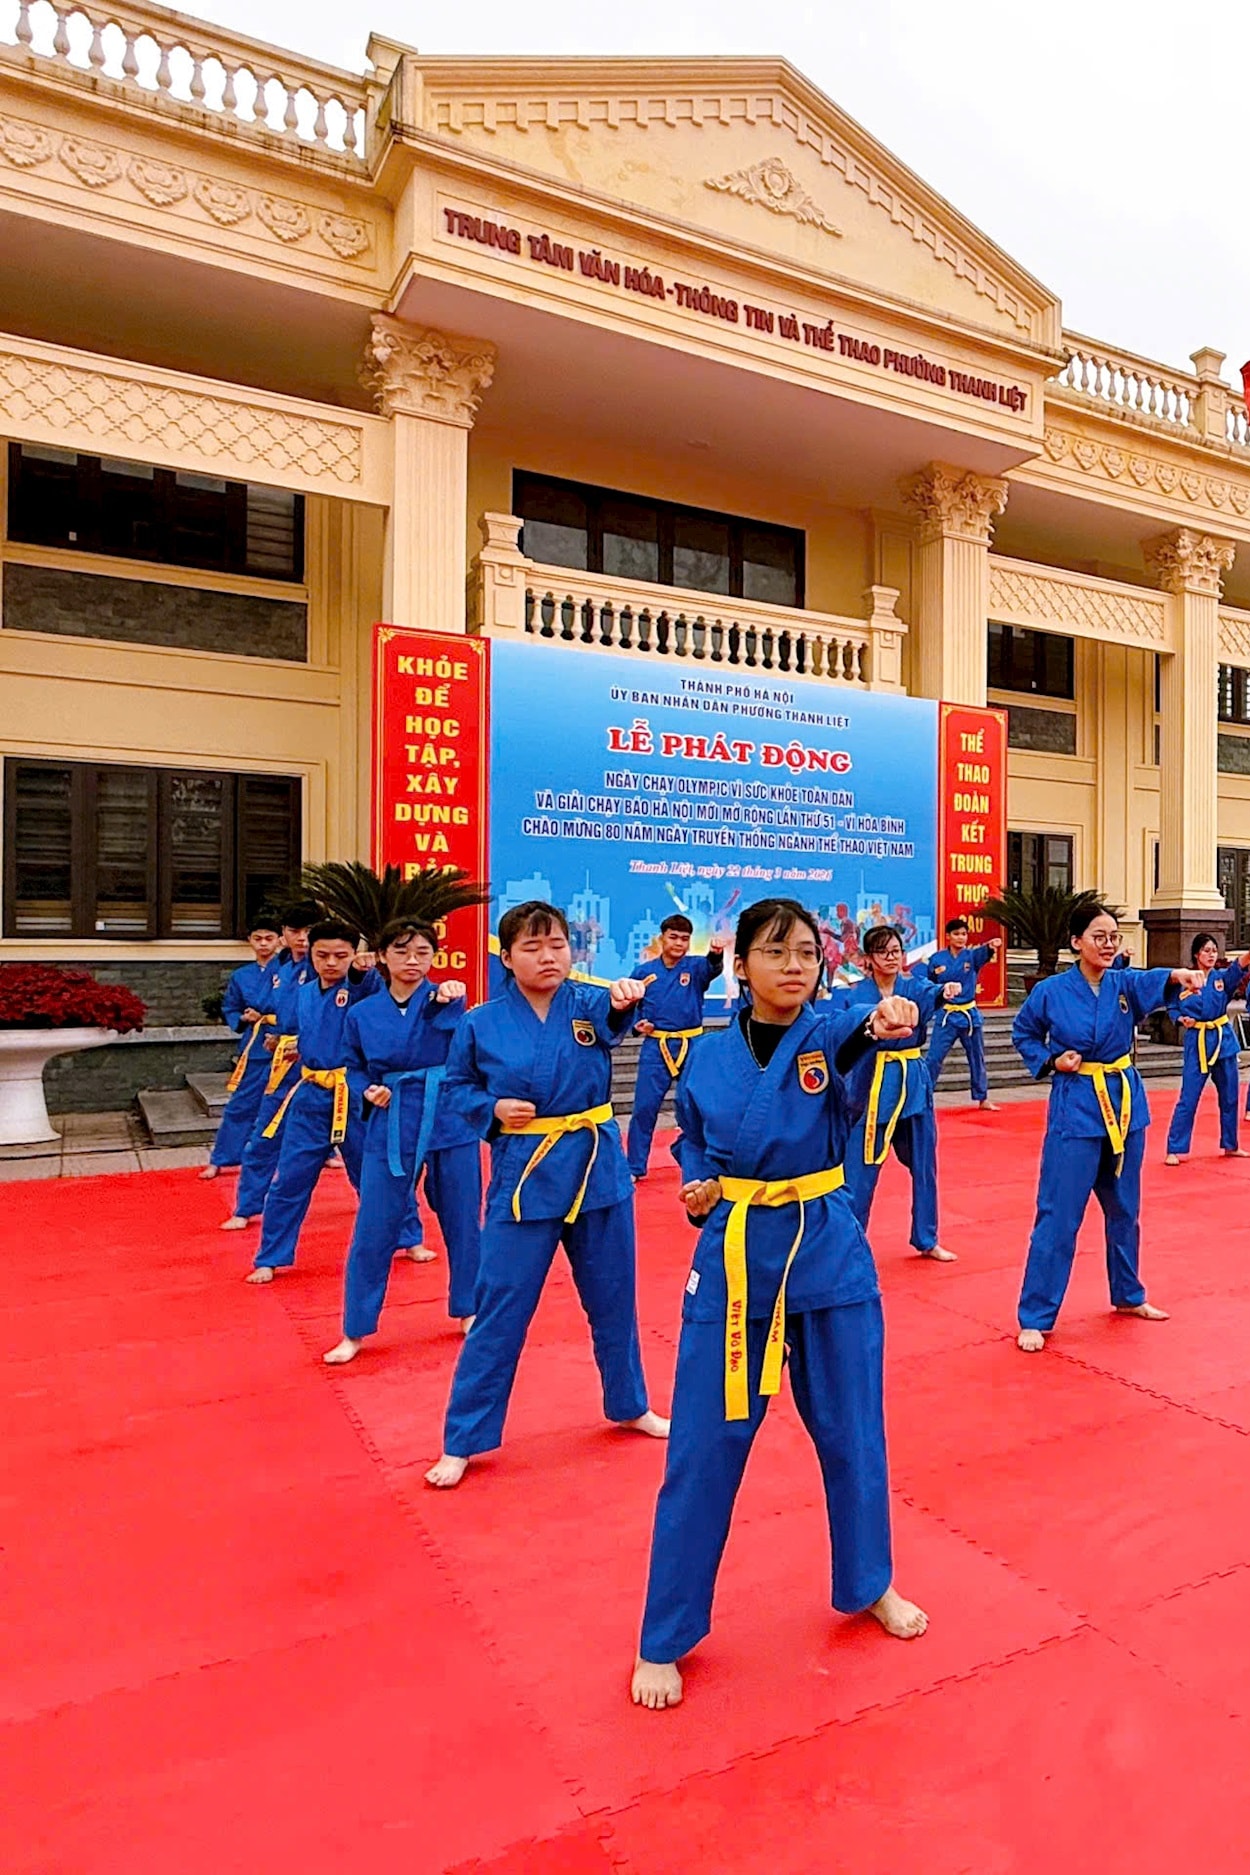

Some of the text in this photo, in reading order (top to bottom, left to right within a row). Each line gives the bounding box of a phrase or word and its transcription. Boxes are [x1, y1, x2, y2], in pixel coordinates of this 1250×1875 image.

[444, 208, 521, 254] TRUNG
[527, 234, 574, 271] TÂM
[578, 250, 621, 286] VĂN
[744, 305, 774, 333] TIN
[779, 313, 800, 341] VÀ
[803, 320, 835, 351] THỂ
[838, 334, 881, 365] THAO
[884, 349, 945, 386] PHƯỜNG
[949, 369, 996, 401] THANH
[999, 385, 1027, 412] LIỆT
[398, 655, 469, 681] KHỎE
[415, 683, 450, 709] ĐỂ
[680, 679, 794, 704] THÀNH PHỐ HÀ NỘI
[611, 685, 850, 729] ỦY BAN NHÂN DÂN PHƯỜNG THANH LIỆT
[405, 715, 460, 741] HỌC
[609, 720, 850, 773] LỄ PHÁT ĐỘNG
[960, 728, 984, 754] THỂ
[405, 744, 461, 769] TẬP,
[406, 772, 459, 796] XÂY
[957, 762, 990, 785] THAO
[606, 771, 853, 806] NGÀY CHẠY OLYMPIC VÌ SỨC KHỎE TOÀN DÂN
[395, 803, 469, 826] DỰNG
[537, 790, 554, 810] VÀ
[558, 790, 584, 811] GIẢI
[588, 796, 621, 817] CHẠY
[625, 797, 649, 817] BÁO
[653, 799, 668, 816] HÀ
[673, 801, 693, 822] NỘI
[697, 802, 718, 820] MỚI
[722, 802, 741, 821] MỞ
[744, 805, 773, 827] RỘNG
[801, 810, 821, 828] THỨ
[823, 815, 835, 829] 51
[845, 813, 855, 830] VÌ
[858, 813, 878, 832] HÒA
[881, 816, 904, 833] BÌNH
[954, 791, 989, 814] ĐOÀN
[415, 831, 449, 853] VÀ
[523, 816, 558, 836] CHÀO
[563, 817, 601, 839] MỪNG
[605, 824, 620, 840] 80
[624, 821, 653, 841] NĂM
[657, 824, 688, 843] NGÀY
[739, 827, 775, 848] THỐNG
[778, 831, 815, 851] NGÀNH
[818, 831, 837, 852] THỂ
[840, 839, 865, 854] THAO
[867, 837, 888, 859] VIỆT
[890, 842, 913, 857] NAM
[961, 821, 986, 844] KẾT
[630, 860, 668, 874] Thanh
[950, 853, 993, 874] TRUNG
[956, 883, 990, 907] THỰC
